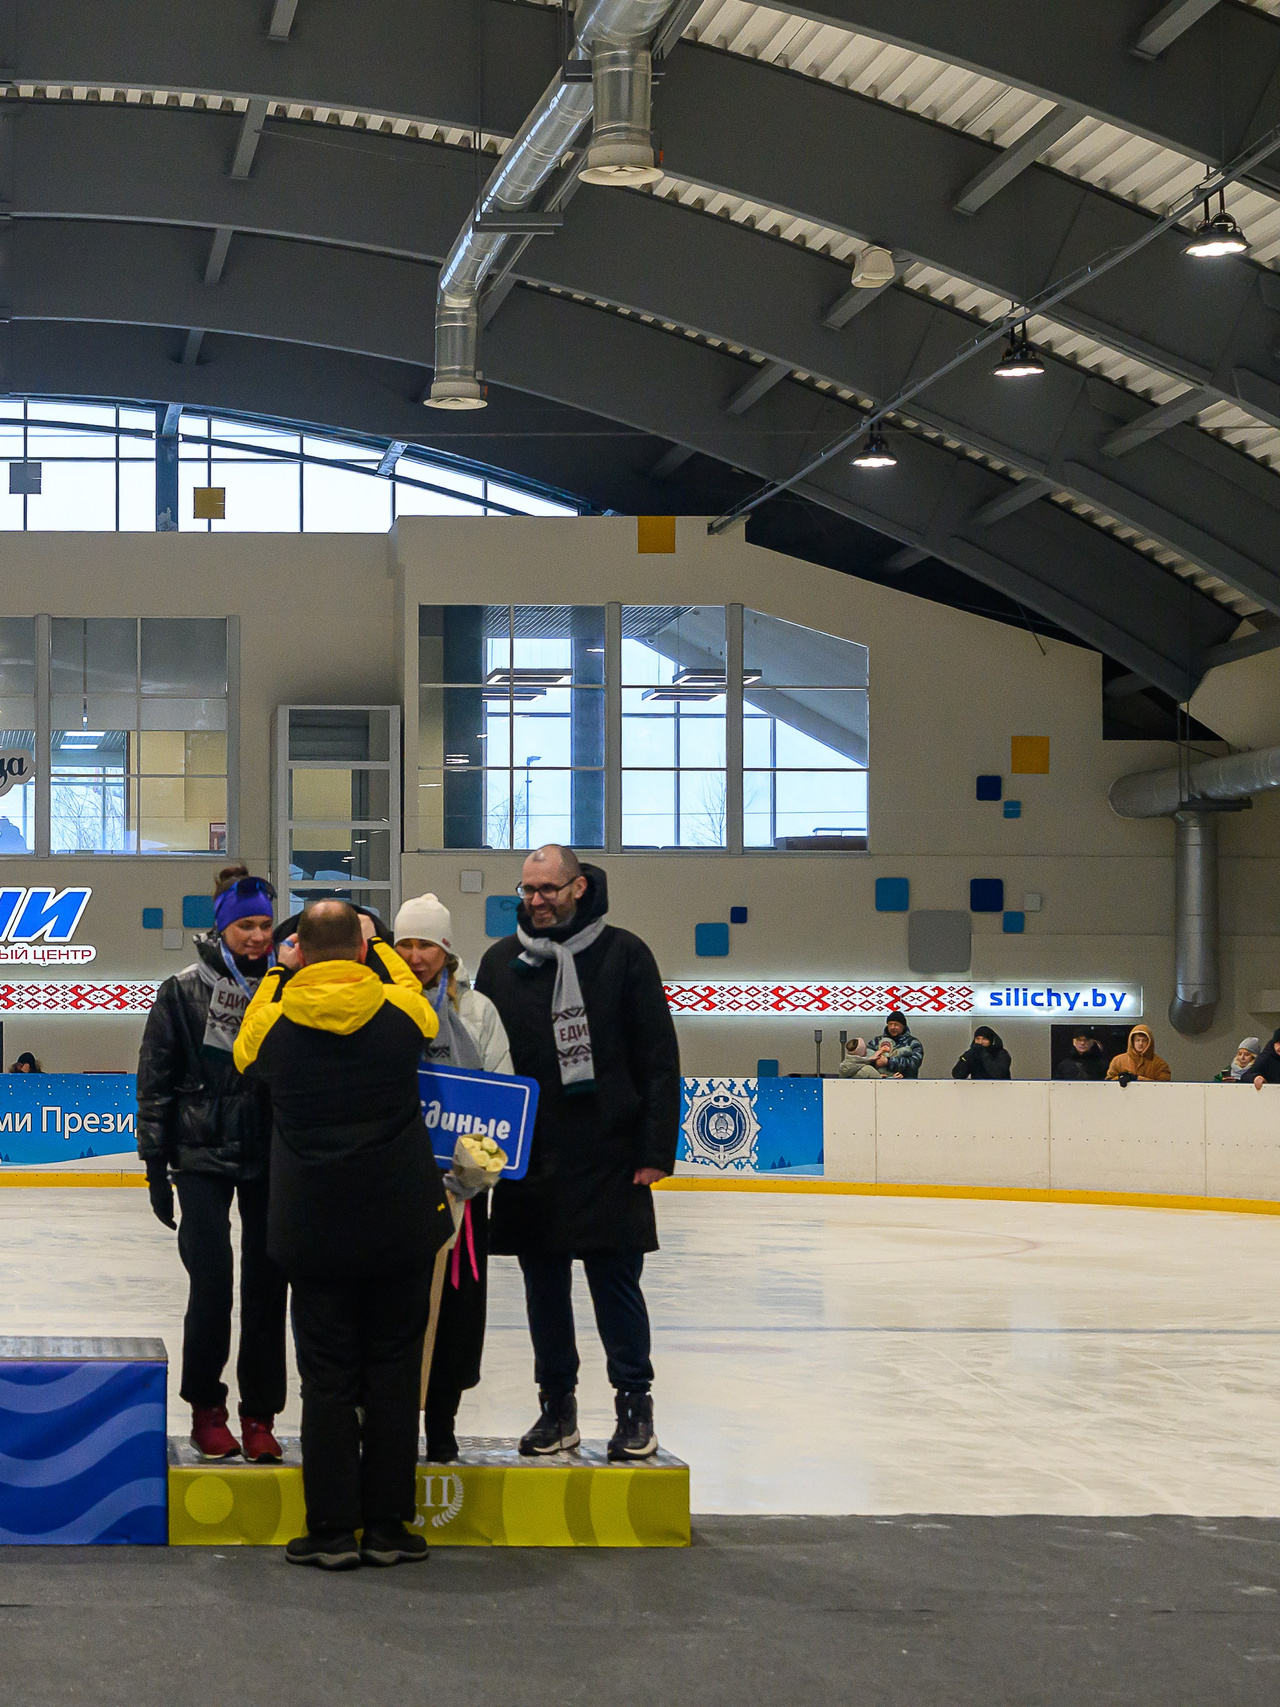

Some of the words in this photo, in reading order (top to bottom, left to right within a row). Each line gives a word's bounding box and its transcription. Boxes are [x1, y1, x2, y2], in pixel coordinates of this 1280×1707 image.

[33, 949, 92, 965] ЦЕНТР
[217, 990, 249, 1011] ЕДИ
[989, 987, 1127, 1012] silichy.by
[559, 1023, 589, 1042] ЕДИ
[41, 1105, 138, 1140] Прези
[416, 1475, 452, 1507] II
